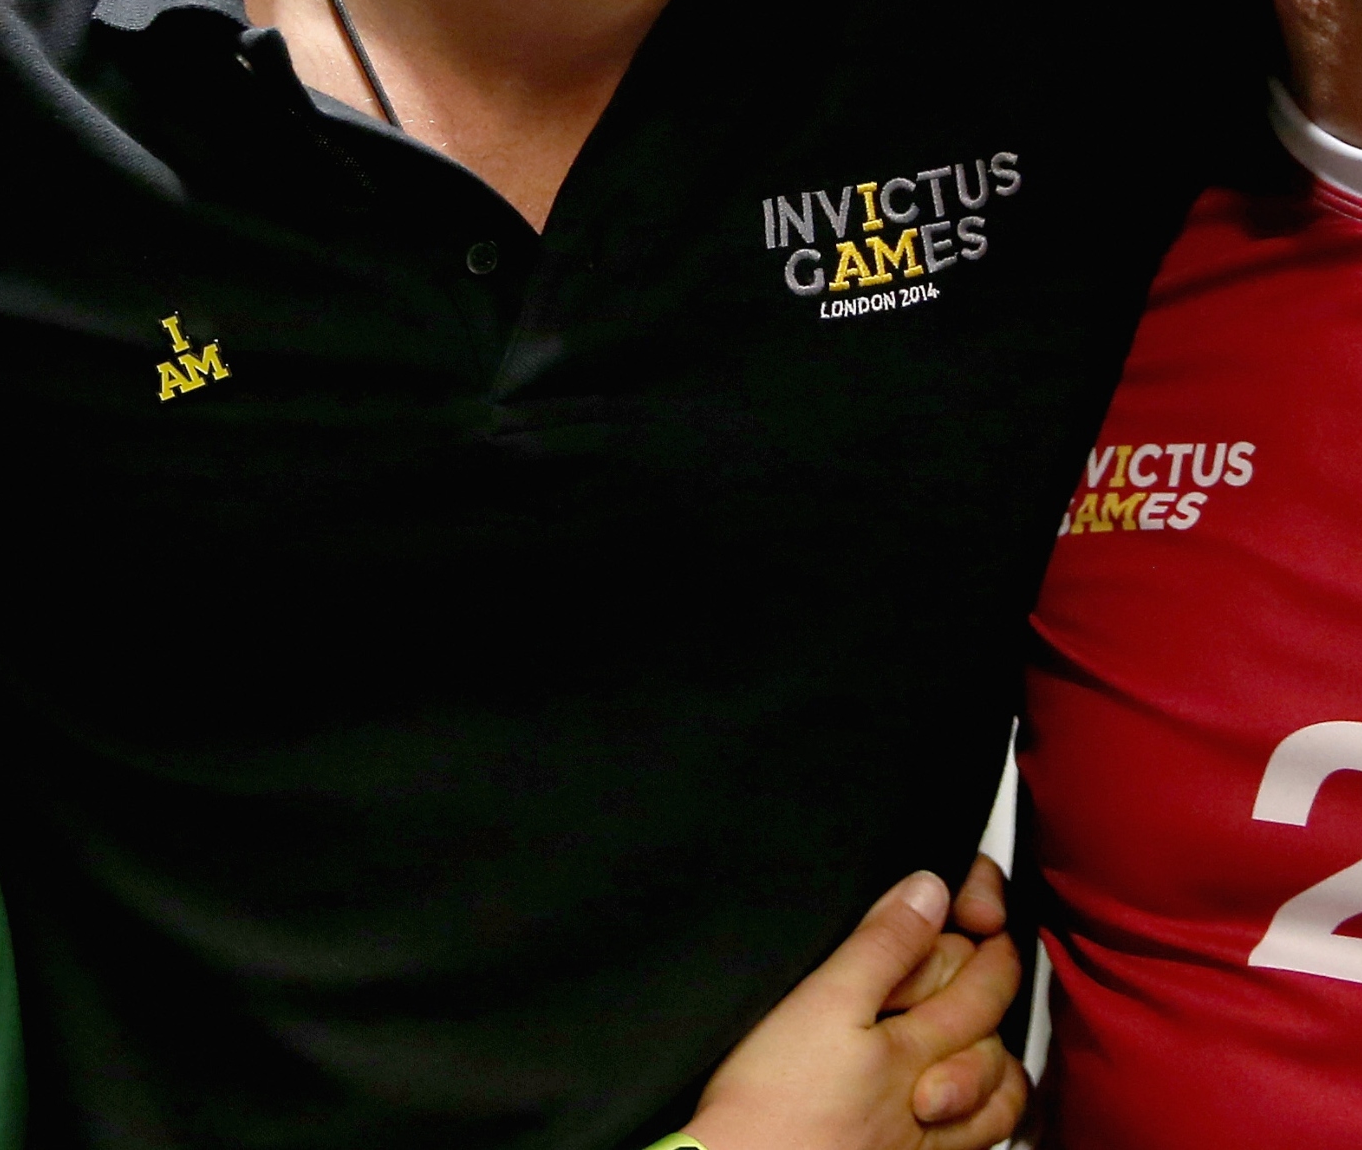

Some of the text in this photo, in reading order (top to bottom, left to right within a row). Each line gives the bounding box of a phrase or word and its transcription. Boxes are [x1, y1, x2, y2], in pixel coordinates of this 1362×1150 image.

[762, 151, 1022, 249] INVICTUS
[784, 215, 988, 296] GAMES
[820, 282, 940, 320] LONDON 2014
[161, 315, 190, 353] I
[156, 343, 230, 401] AM
[1086, 441, 1256, 489] VICTUS
